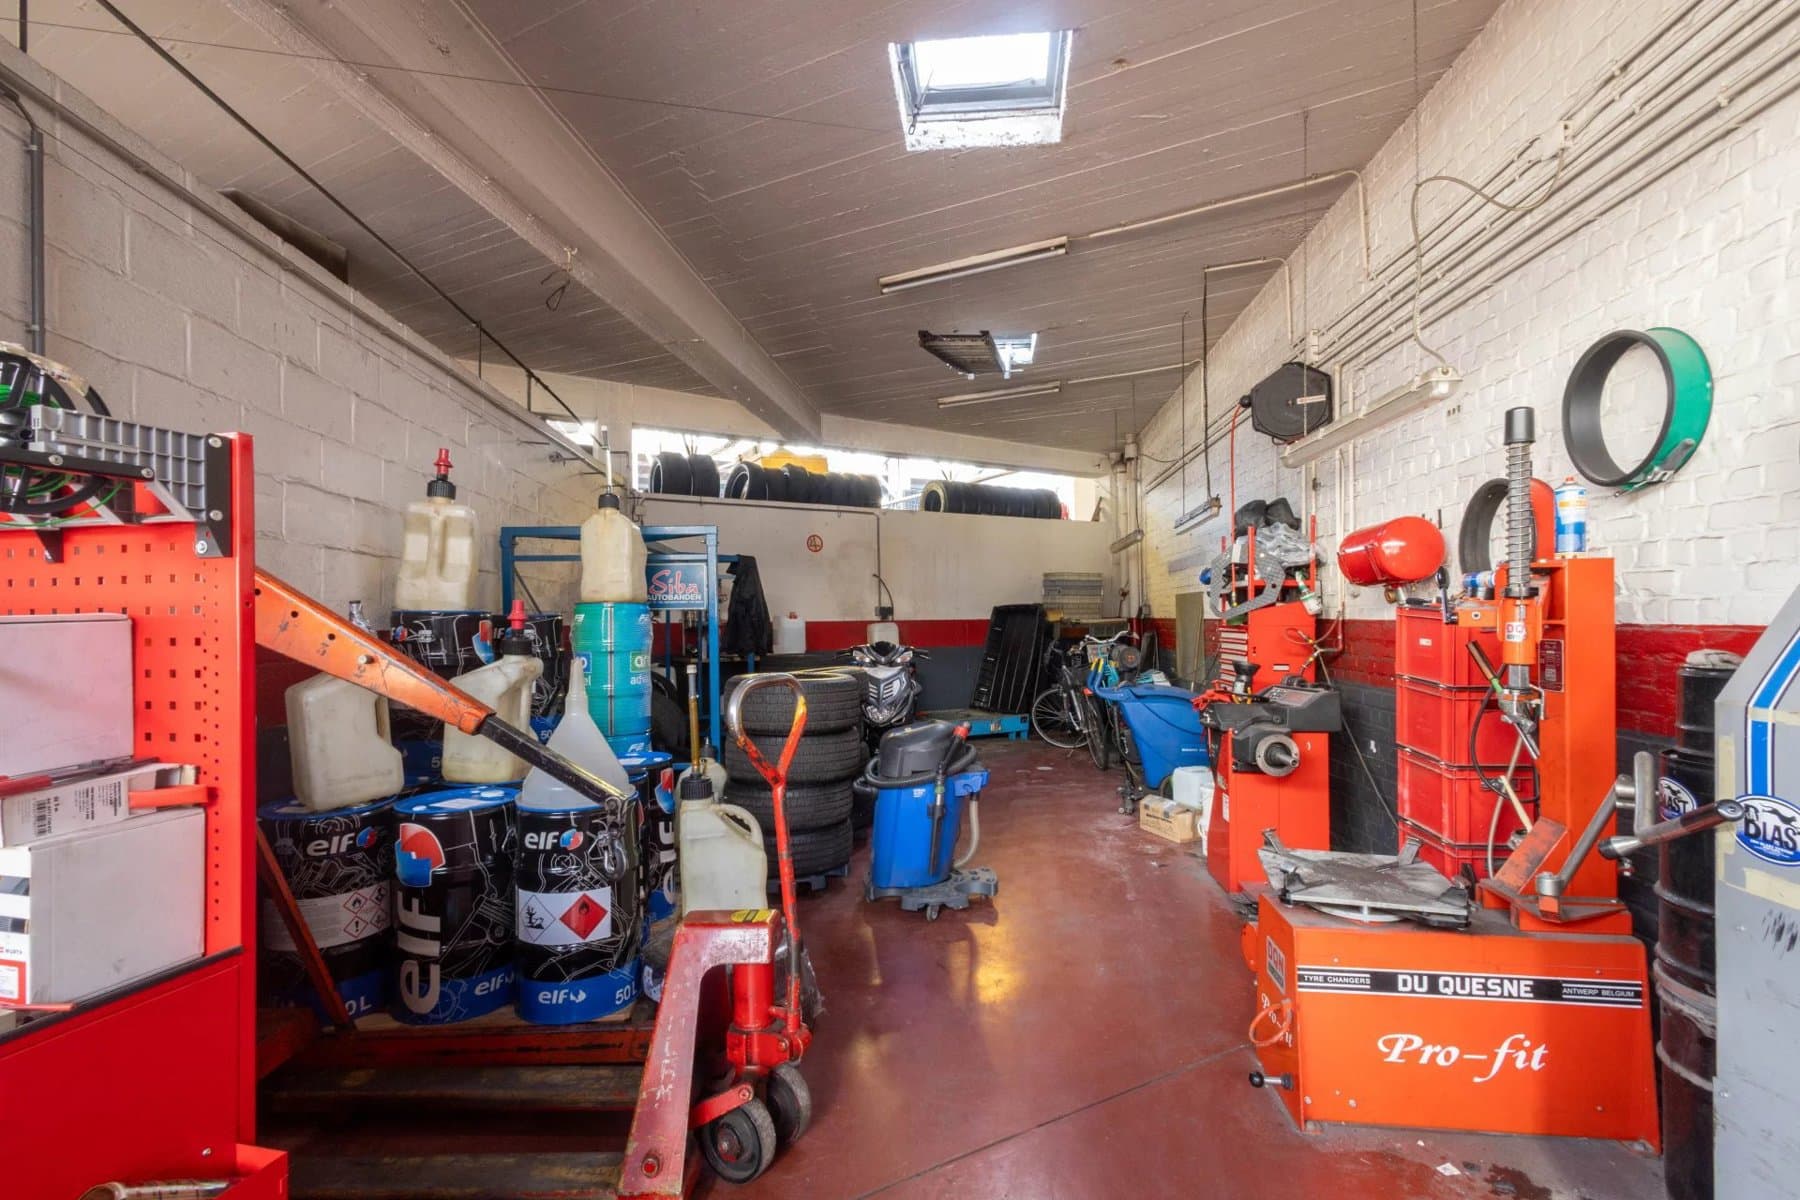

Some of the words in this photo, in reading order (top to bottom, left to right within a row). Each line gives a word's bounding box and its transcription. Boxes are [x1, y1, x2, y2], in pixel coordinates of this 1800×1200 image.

[649, 569, 699, 595] Siba
[1743, 803, 1800, 851] BLAS
[306, 832, 355, 857] elf
[524, 831, 560, 850] elf
[398, 890, 440, 1014] elf
[474, 972, 505, 996] elf
[1303, 974, 1324, 984] TYRE
[1327, 975, 1371, 985] CHANGERS
[1397, 974, 1429, 993] DU
[1438, 976, 1534, 998] QUESNE
[537, 988, 569, 1005] elf
[1562, 987, 1599, 996] ANTWERP
[1601, 988, 1635, 998] BELGIUM
[1377, 1033, 1549, 1083] Pro-fit
